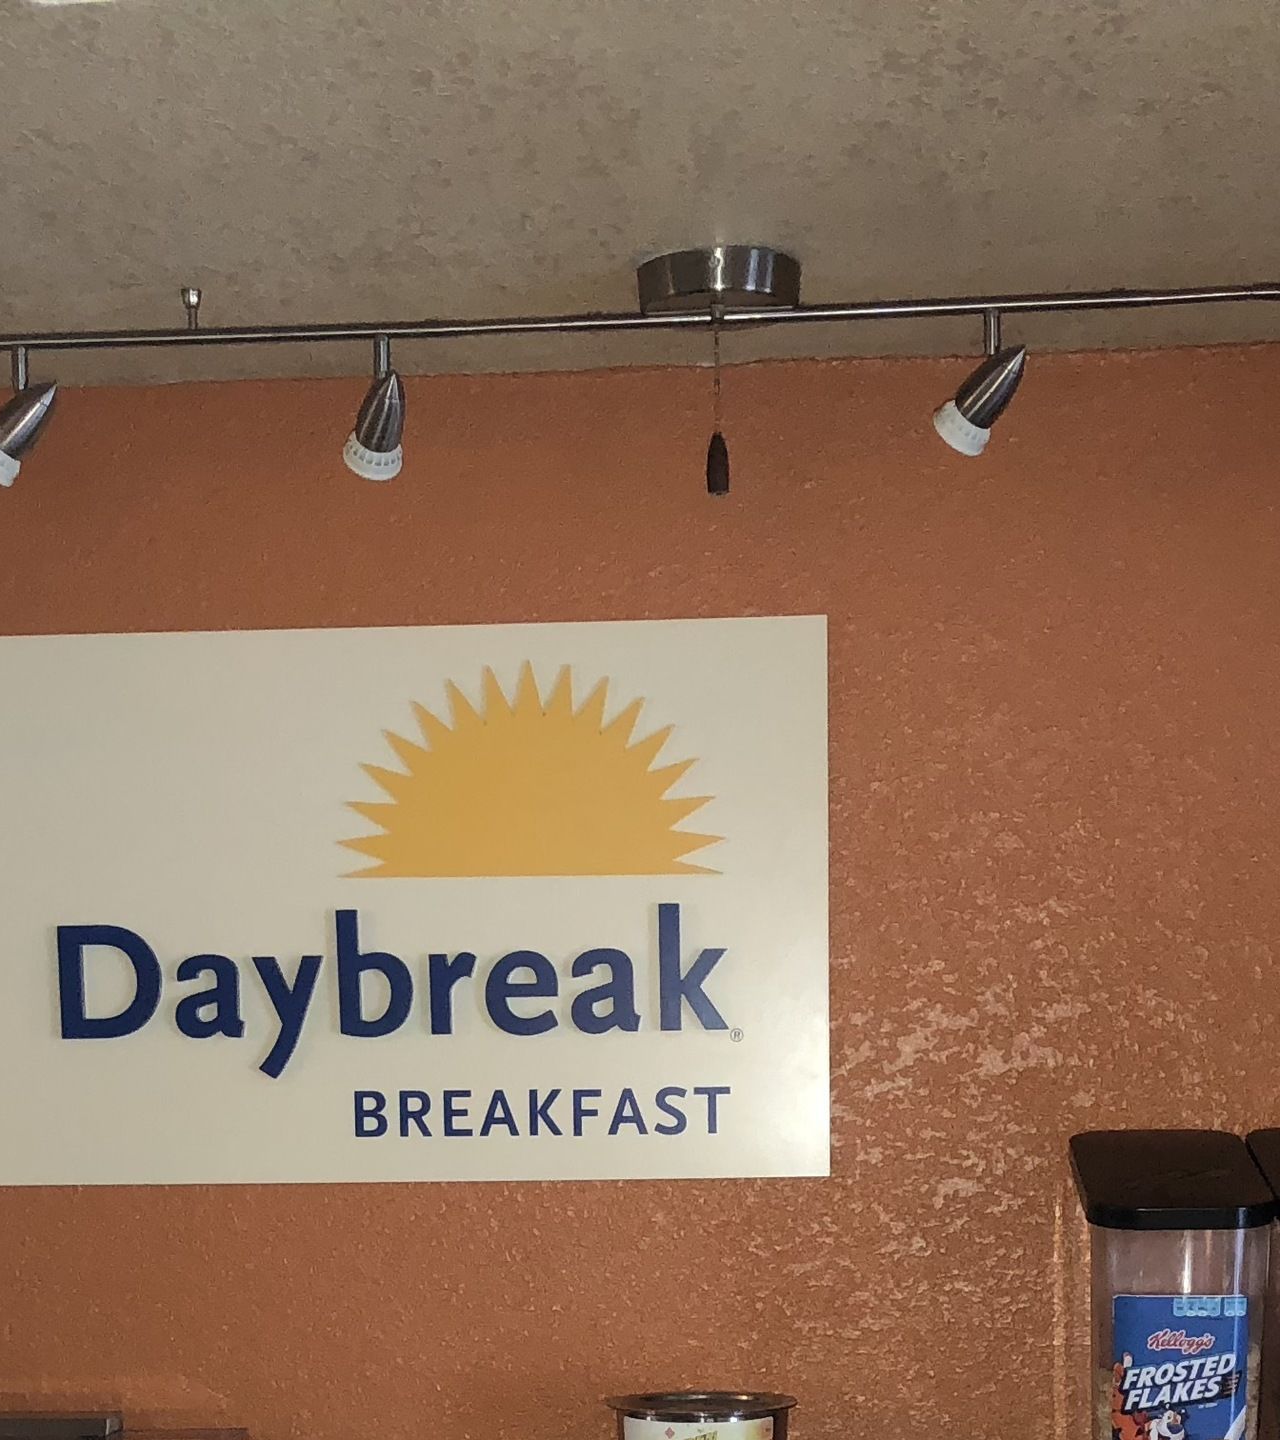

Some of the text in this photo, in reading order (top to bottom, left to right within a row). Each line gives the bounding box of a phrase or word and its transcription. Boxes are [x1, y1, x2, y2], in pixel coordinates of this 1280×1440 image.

[56, 903, 729, 1078] Daybreak
[353, 1086, 732, 1138] BREAKFAST
[1147, 1329, 1215, 1354] Kellogg's
[1122, 1353, 1237, 1391] FROSTED
[1124, 1376, 1223, 1411] FLAKES
